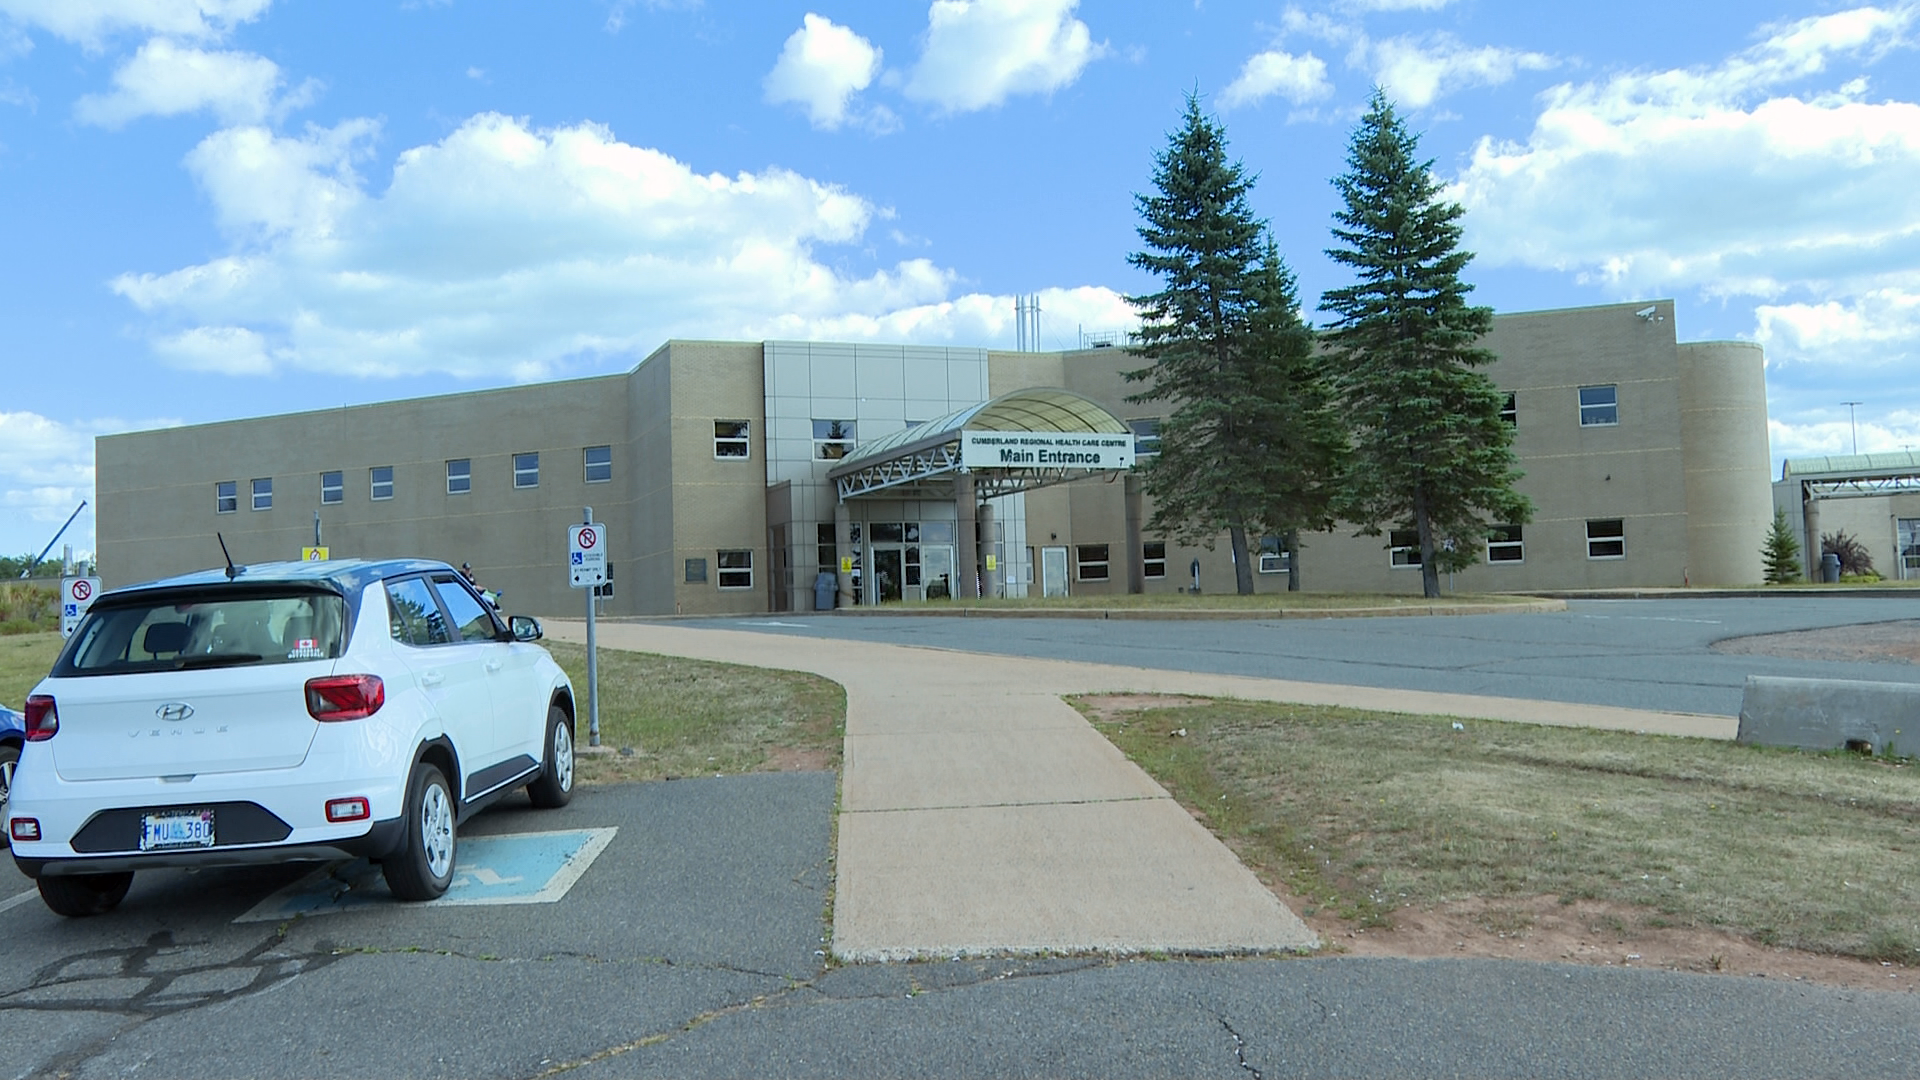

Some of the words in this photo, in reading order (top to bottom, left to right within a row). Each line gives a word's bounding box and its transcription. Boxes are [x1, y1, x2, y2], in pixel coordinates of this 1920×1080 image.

[971, 437, 1018, 445] CUMBERLAND
[1020, 438, 1054, 446] REGIONAL
[1082, 439, 1099, 447] CARE
[1101, 440, 1126, 448] CENTRE
[1000, 448, 1034, 463] Main
[1038, 449, 1101, 464] Entrance
